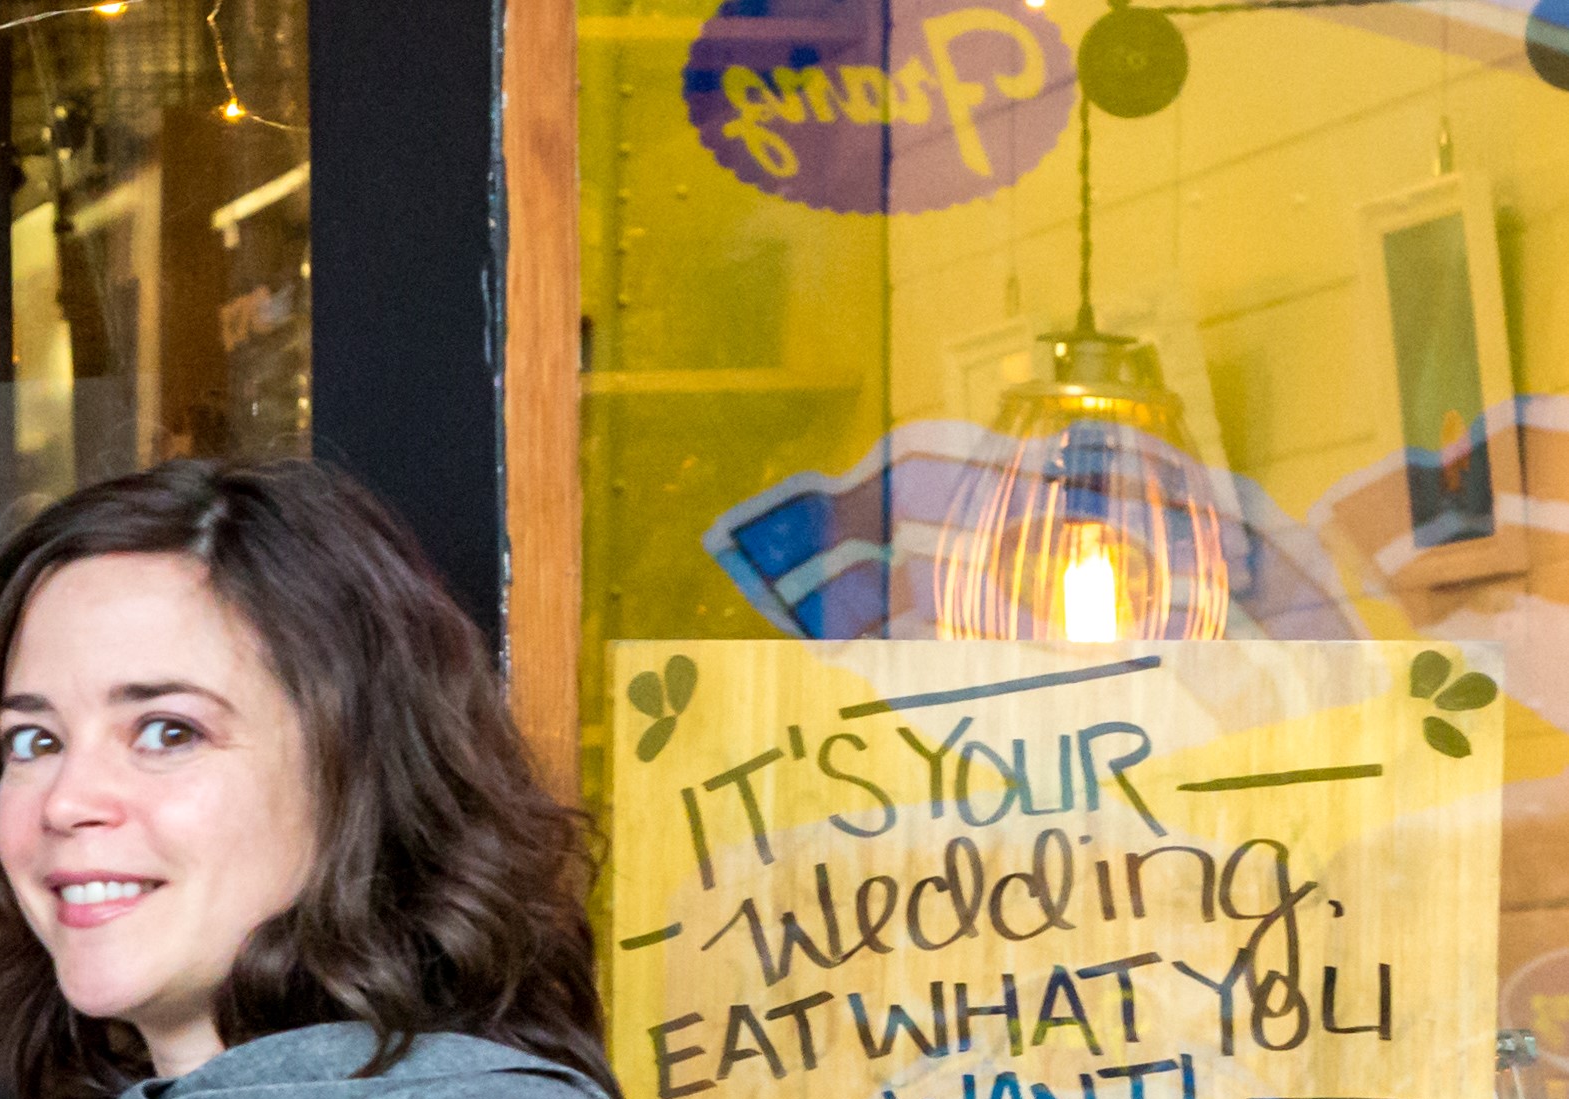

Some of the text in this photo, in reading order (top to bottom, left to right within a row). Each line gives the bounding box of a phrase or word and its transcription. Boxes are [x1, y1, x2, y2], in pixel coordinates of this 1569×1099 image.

[681, 716, 1167, 889] IT'S YOUR
[846, 951, 1164, 1060] WHAT
[1172, 948, 1392, 1057] YOU
